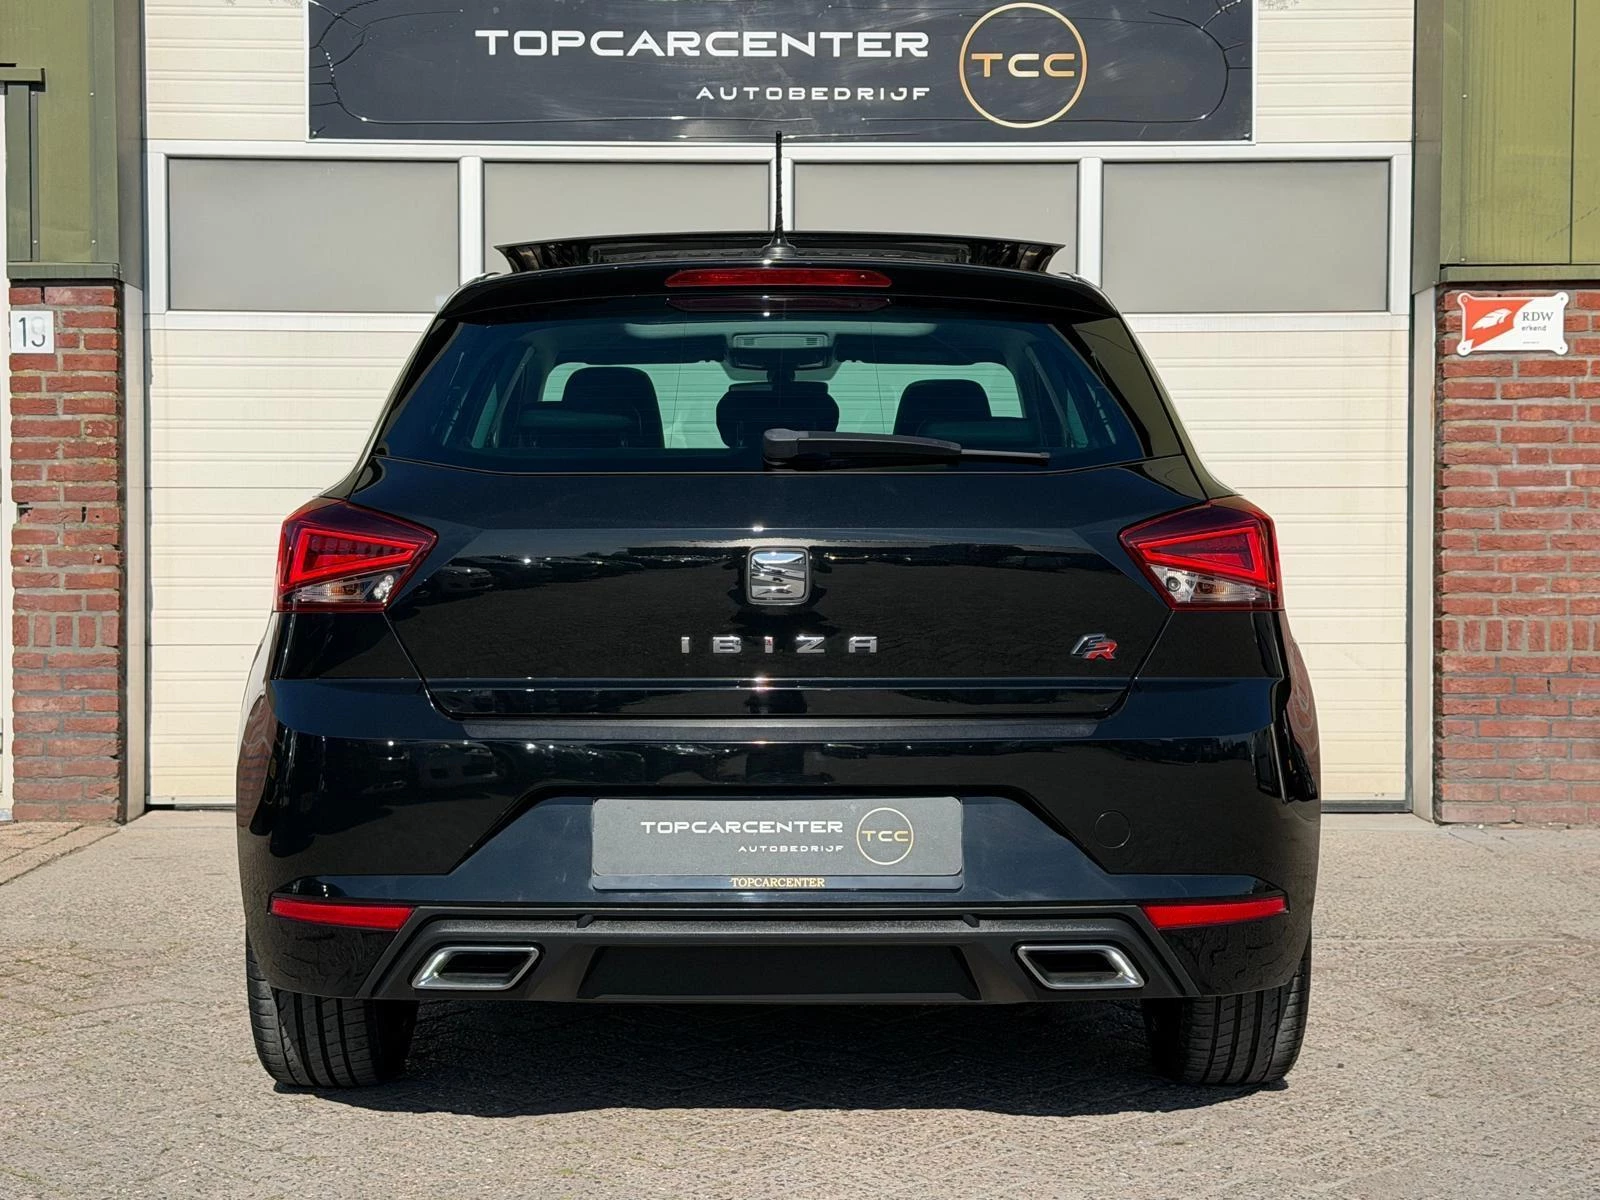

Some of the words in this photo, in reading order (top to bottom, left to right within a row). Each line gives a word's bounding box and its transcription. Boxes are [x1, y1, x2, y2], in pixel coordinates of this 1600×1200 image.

[475, 29, 929, 58] TOPCARCENTER
[971, 53, 1075, 78] TCC
[696, 86, 930, 101] AUTOBEDRIJF
[1522, 311, 1554, 321] RDW
[680, 634, 878, 654] IBIZA
[1071, 633, 1117, 660] FR
[640, 820, 844, 834] TOPCARCENTER
[861, 830, 909, 842] TCC
[737, 845, 844, 853] AUTOBEDRIJF
[730, 877, 825, 888] TOPCARCENTER
